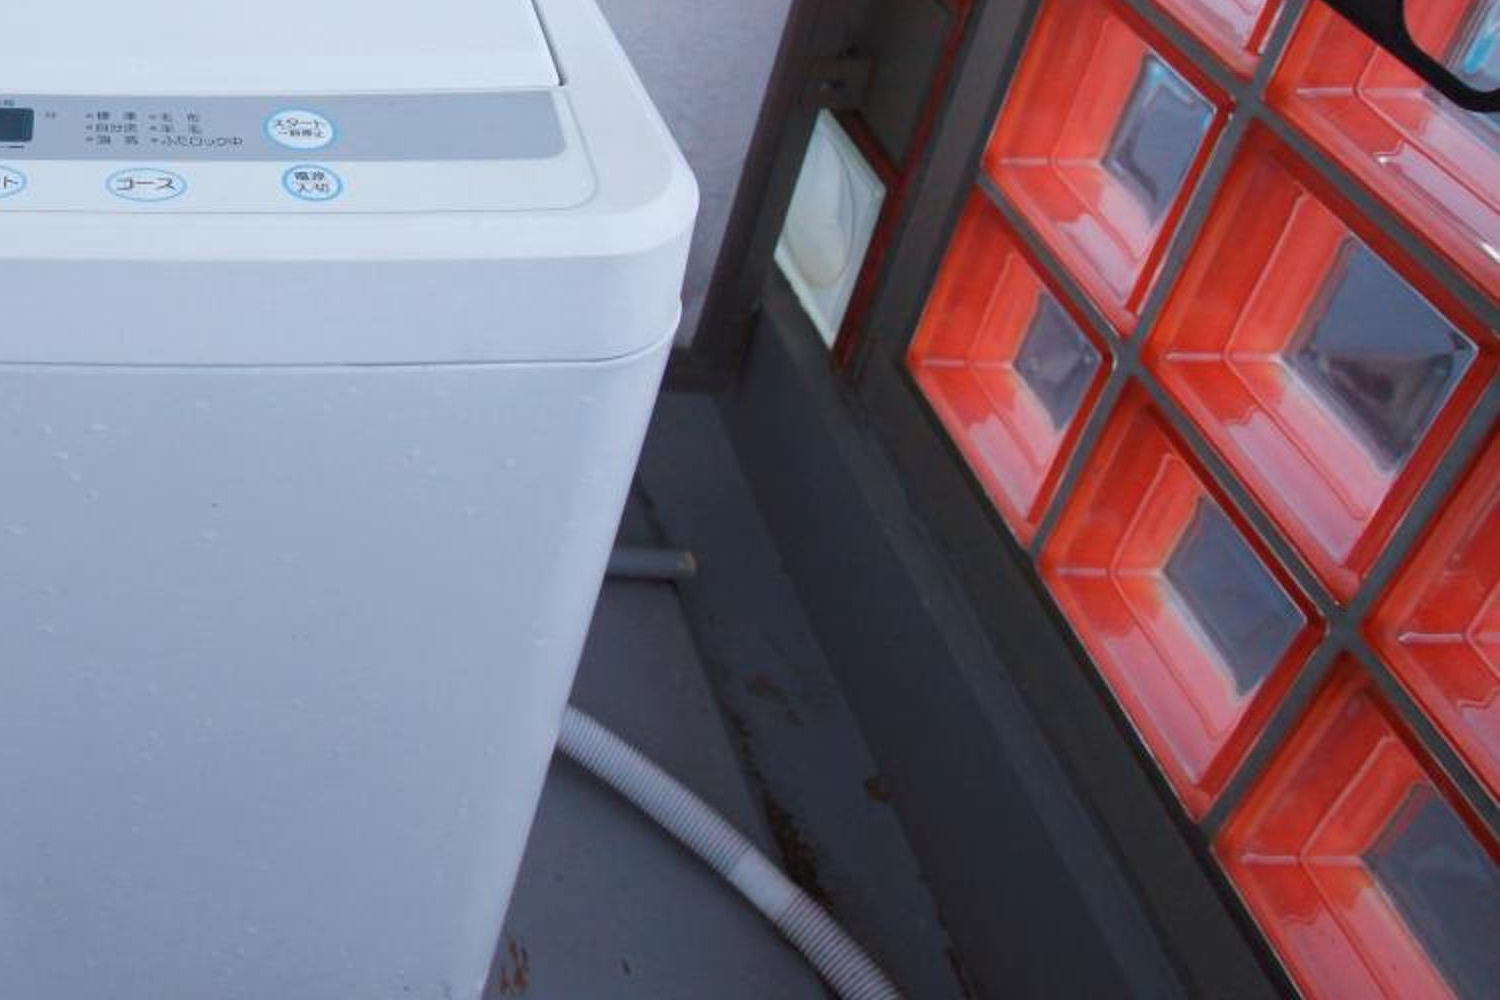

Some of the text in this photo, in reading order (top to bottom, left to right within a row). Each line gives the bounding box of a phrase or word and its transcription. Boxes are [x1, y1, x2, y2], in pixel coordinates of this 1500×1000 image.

[275, 118, 326, 128] スタート
[116, 176, 178, 192] コース
